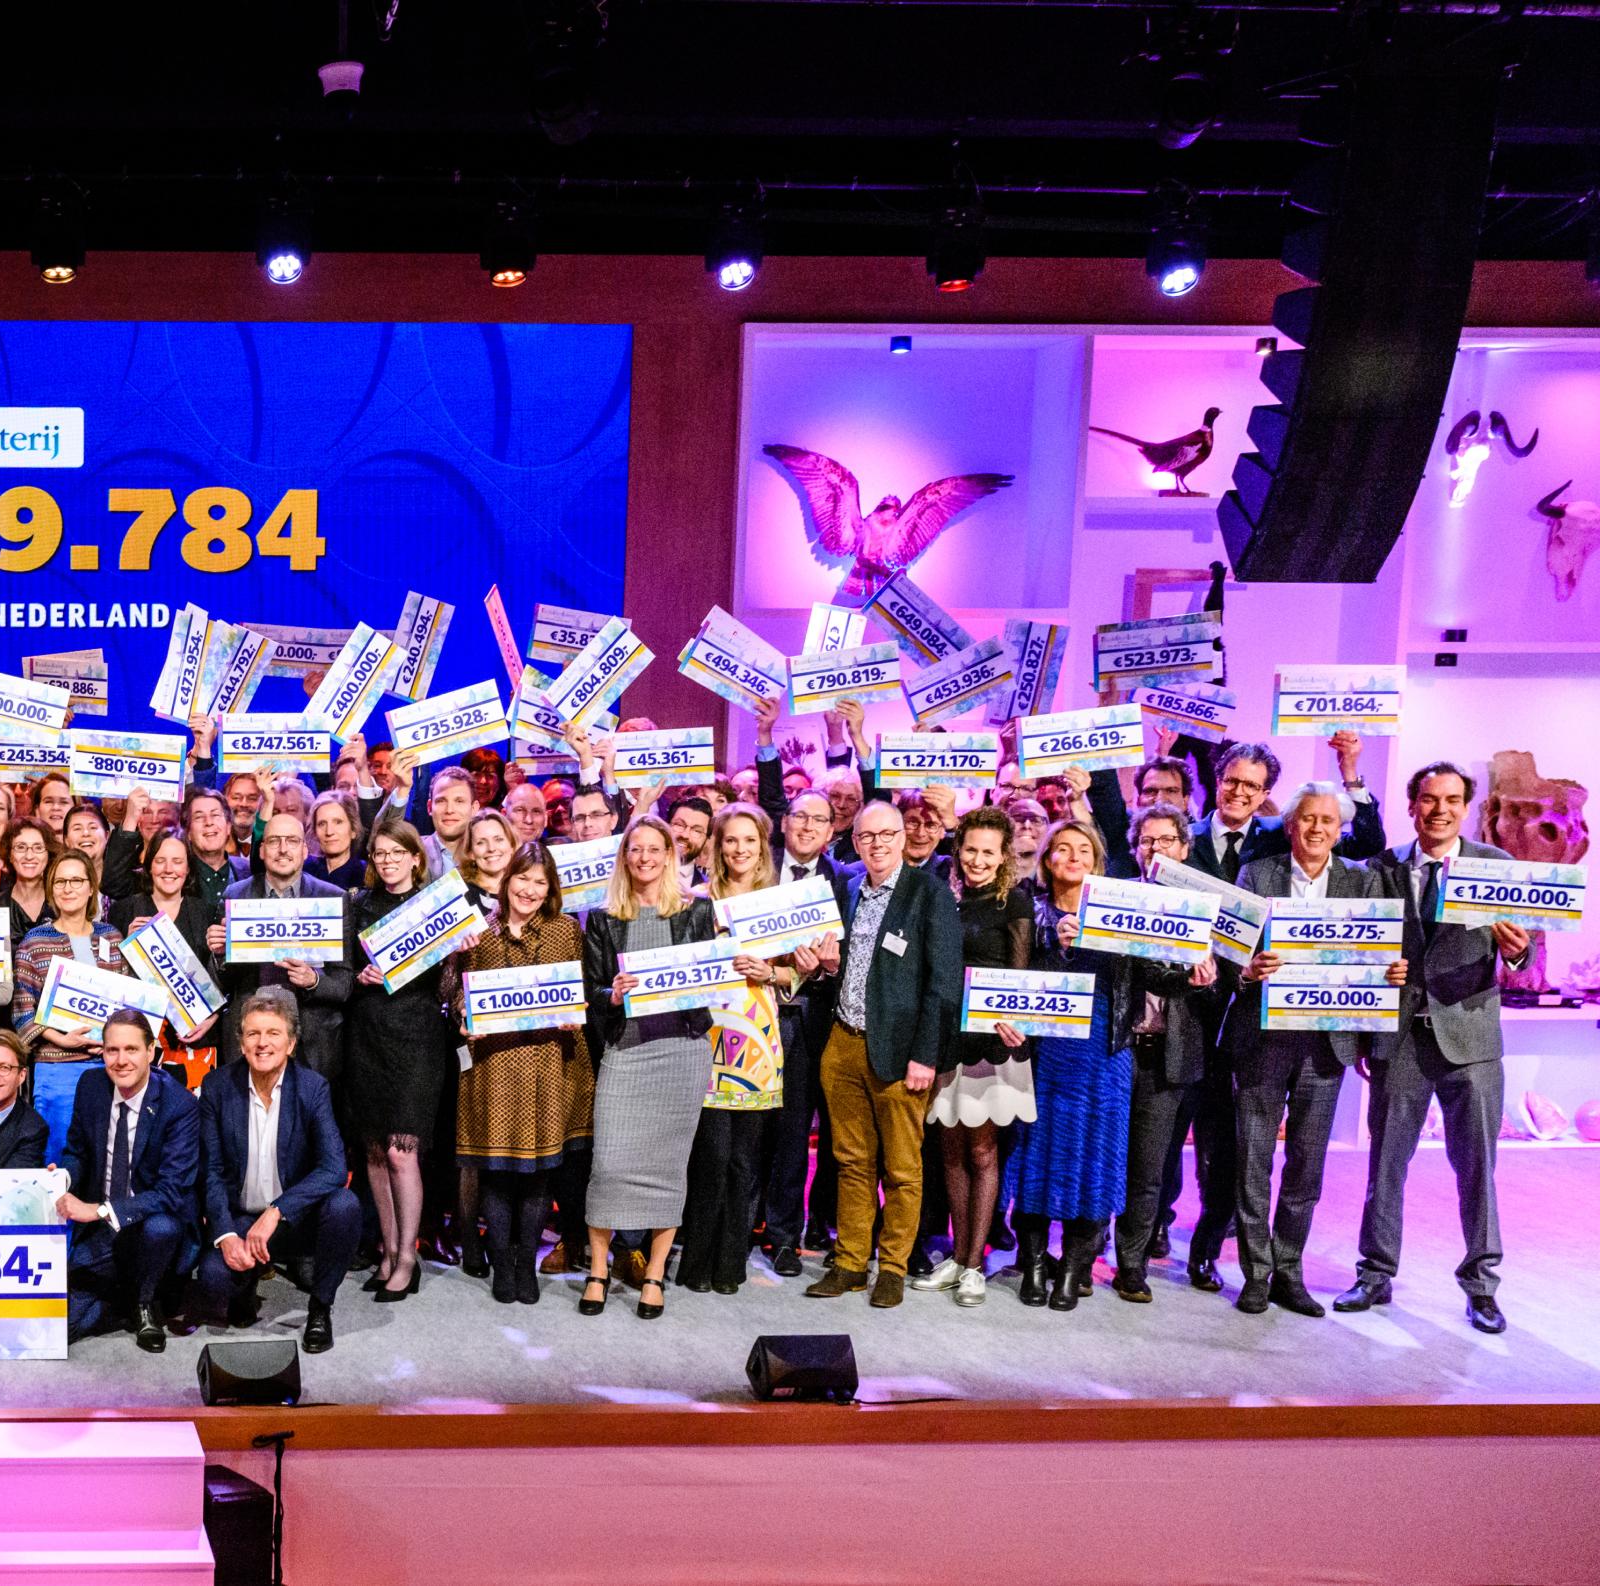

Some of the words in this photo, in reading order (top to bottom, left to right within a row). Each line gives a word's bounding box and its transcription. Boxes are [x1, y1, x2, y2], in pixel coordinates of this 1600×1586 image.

[889, 600, 950, 660] €649.084,-
[402, 609, 434, 685] €240.494,-
[1113, 647, 1198, 667] €523.973,-
[180, 630, 204, 706] €473.954,-
[218, 643, 255, 713] €444.792,-
[570, 644, 630, 708] €804.809,-
[704, 652, 770, 698] €494.346,-
[807, 668, 886, 690] €790.819,-
[1017, 637, 1045, 711] €250.827,-
[45, 681, 98, 697] 639.886,-
[332, 648, 381, 719] €400.000,-
[925, 664, 996, 705] €453.936,-
[1146, 693, 1220, 721] €185.866,-
[1295, 698, 1384, 712] €701.864,-
[411, 709, 490, 742] €735.928,-
[232, 736, 321, 752] €8.747.561,-
[1039, 731, 1127, 754] €266.619,-
[628, 750, 695, 766] €45.361,-
[892, 754, 986, 768] €1.271.170,-
[1453, 883, 1577, 908] €1.200.000,-
[245, 923, 329, 938] €350.253,-
[748, 908, 827, 937] €500.000,-
[1100, 912, 1195, 938] €418.000,-
[1288, 922, 1386, 941] €465.275,-
[389, 909, 459, 963] €500.000,-
[150, 944, 198, 1010] €371.153,-
[644, 964, 728, 990] €479.317,-
[477, 986, 578, 1010] €1.000.000,-
[984, 992, 1077, 1012] €283.243,-
[1284, 989, 1382, 1007] €750.000,-
